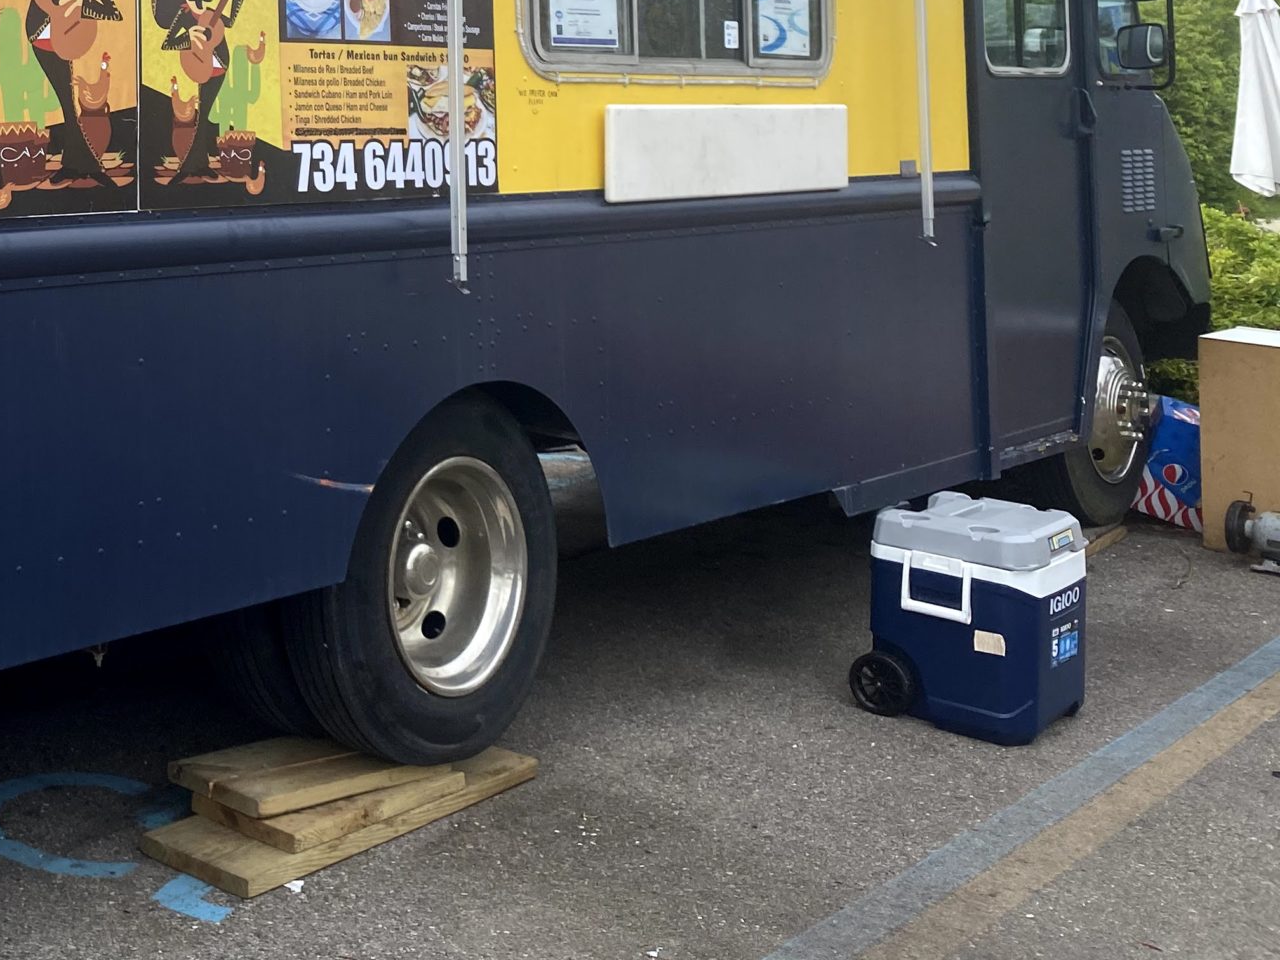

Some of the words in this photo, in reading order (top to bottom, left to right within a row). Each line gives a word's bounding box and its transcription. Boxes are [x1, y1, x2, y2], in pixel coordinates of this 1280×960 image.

[309, 49, 335, 60] Tortas
[347, 50, 380, 60] Mexican
[384, 51, 398, 61] bun
[401, 52, 437, 62] Sandwich
[293, 142, 358, 192] 734
[1049, 586, 1079, 615] IGLOO
